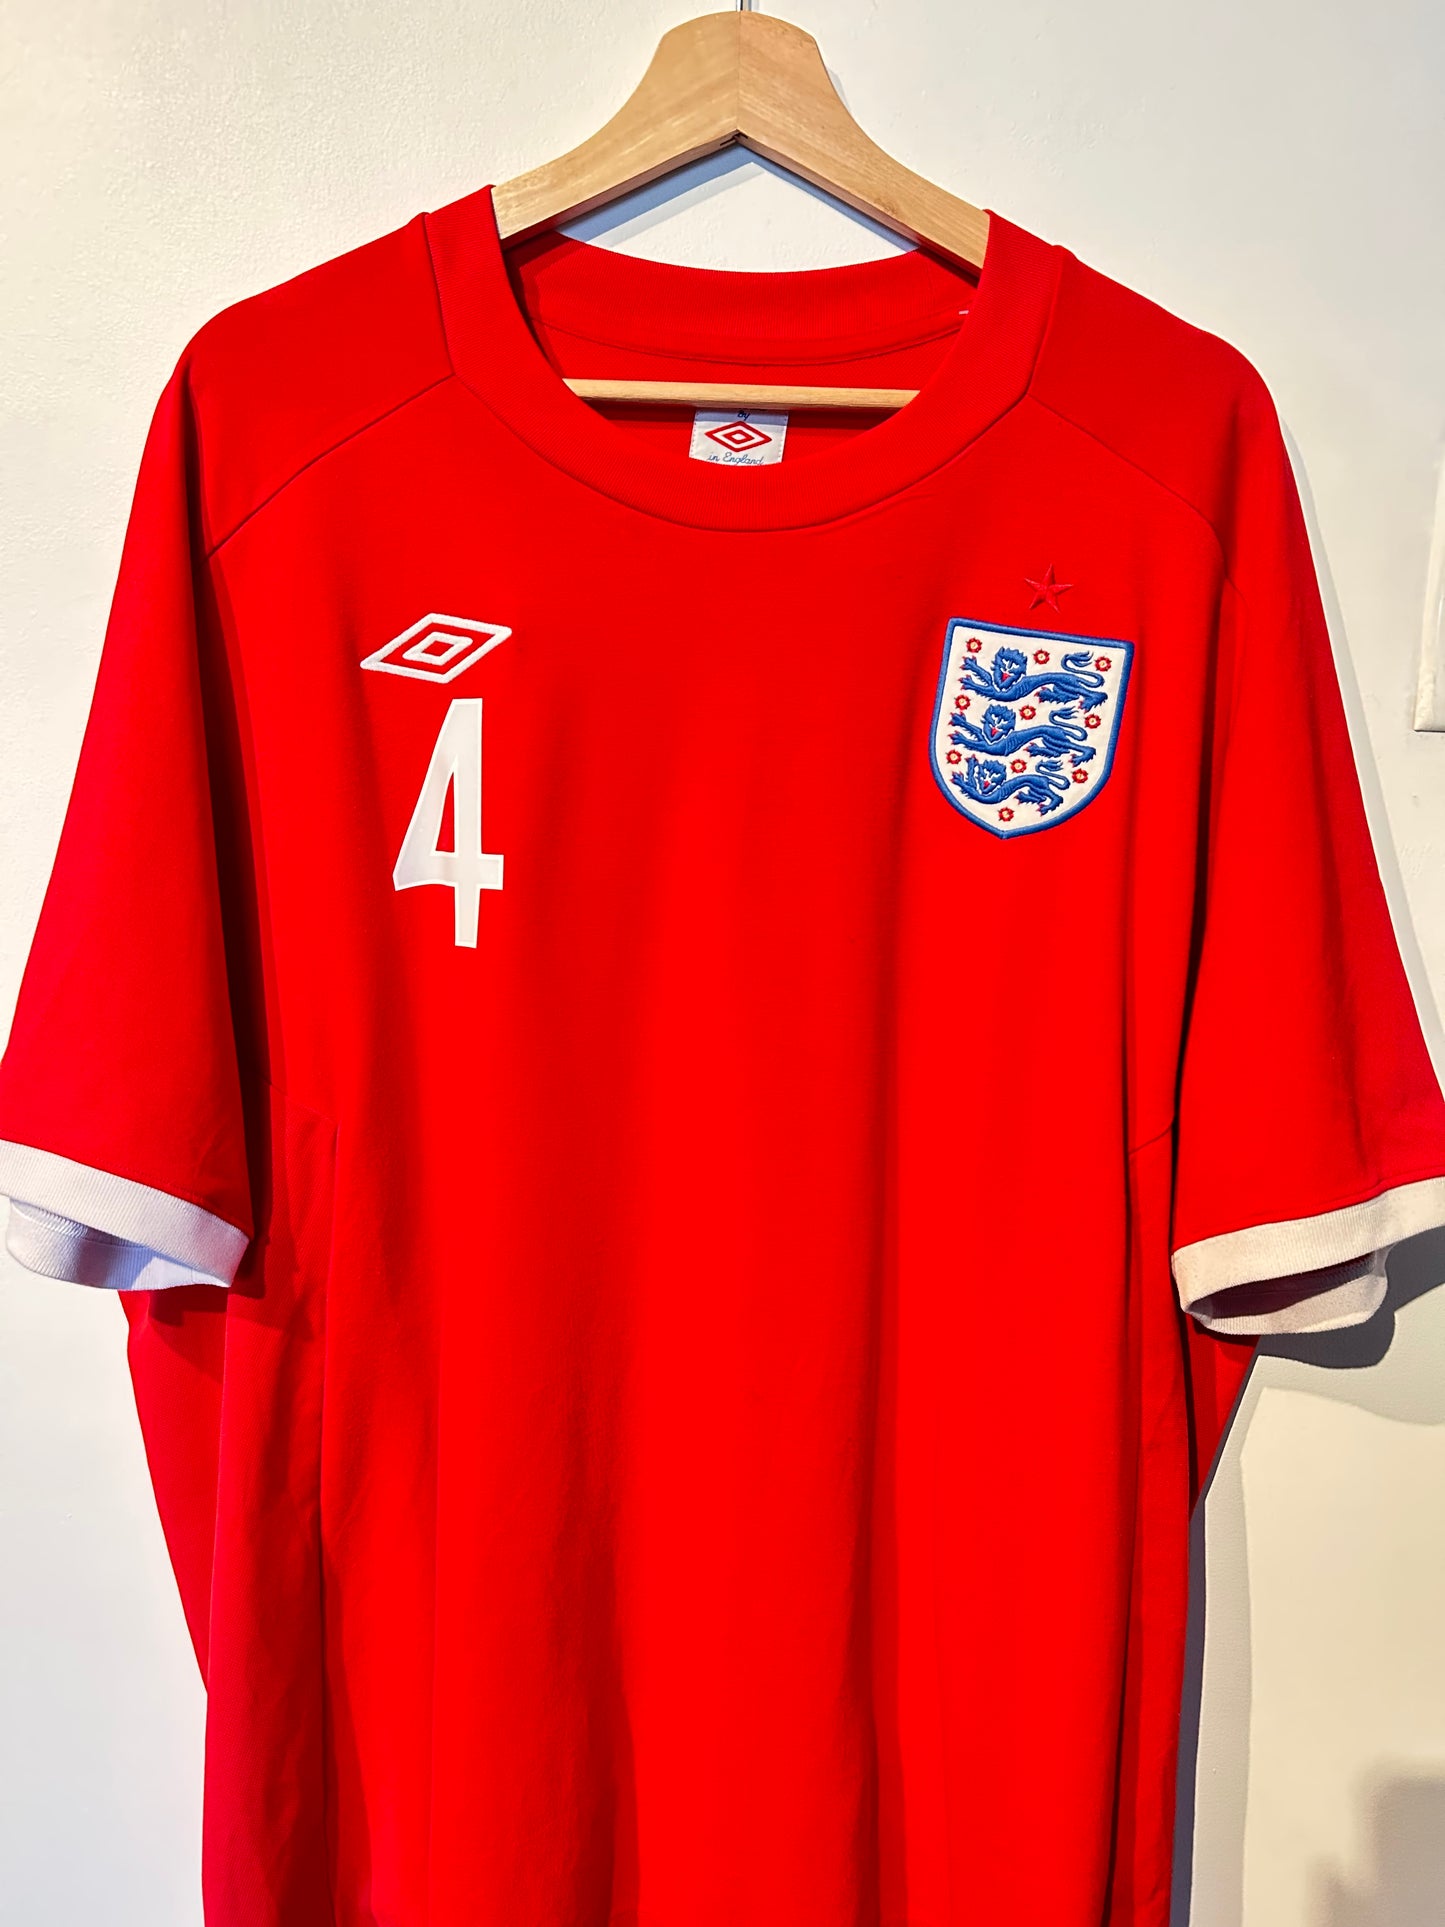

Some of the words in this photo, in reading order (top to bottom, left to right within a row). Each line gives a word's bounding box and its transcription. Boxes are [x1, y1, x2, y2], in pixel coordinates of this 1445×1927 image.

[707, 452, 720, 462] in
[723, 451, 764, 465] England
[393, 698, 504, 948] 4
